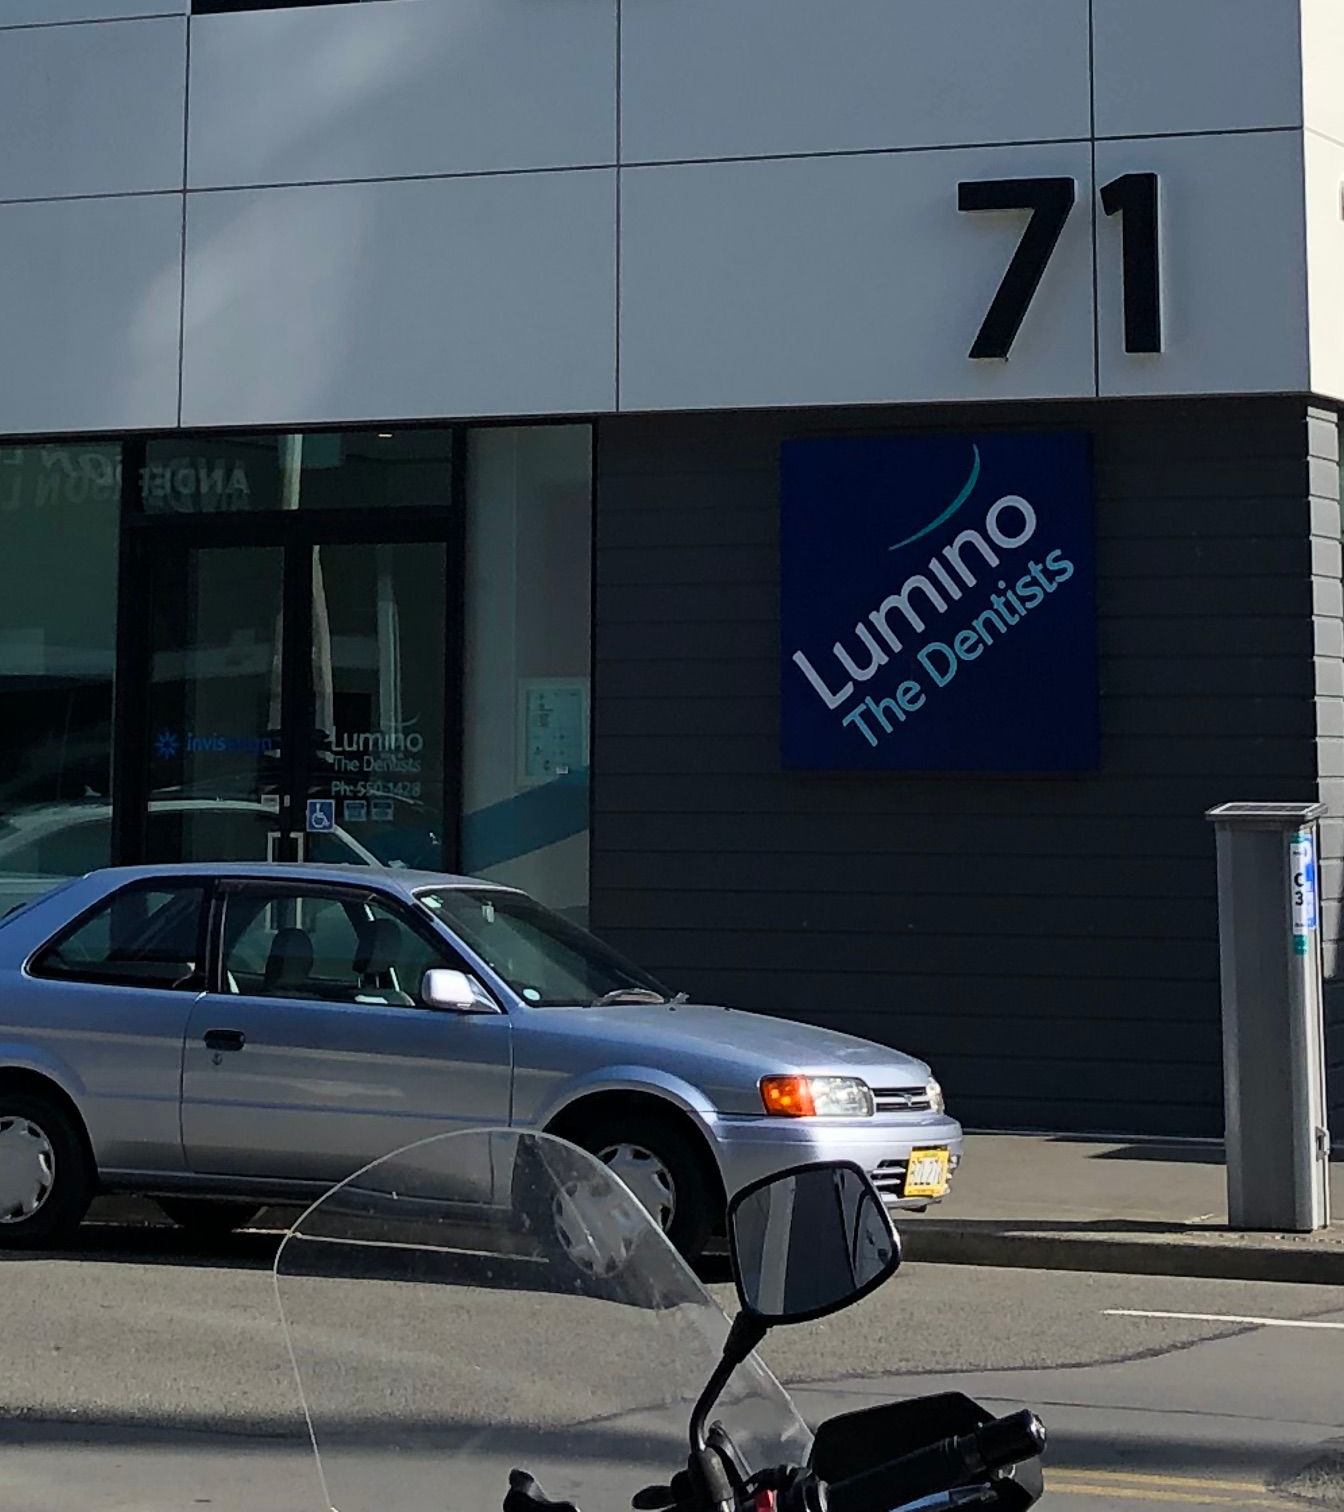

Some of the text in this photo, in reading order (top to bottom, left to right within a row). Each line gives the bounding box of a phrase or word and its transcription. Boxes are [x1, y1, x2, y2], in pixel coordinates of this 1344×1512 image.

[958, 172, 1161, 359] 71
[792, 494, 1037, 710] Lumino
[843, 548, 1075, 747] The Dentists
[331, 725, 424, 752] Lumino
[334, 754, 422, 772] The Dentists
